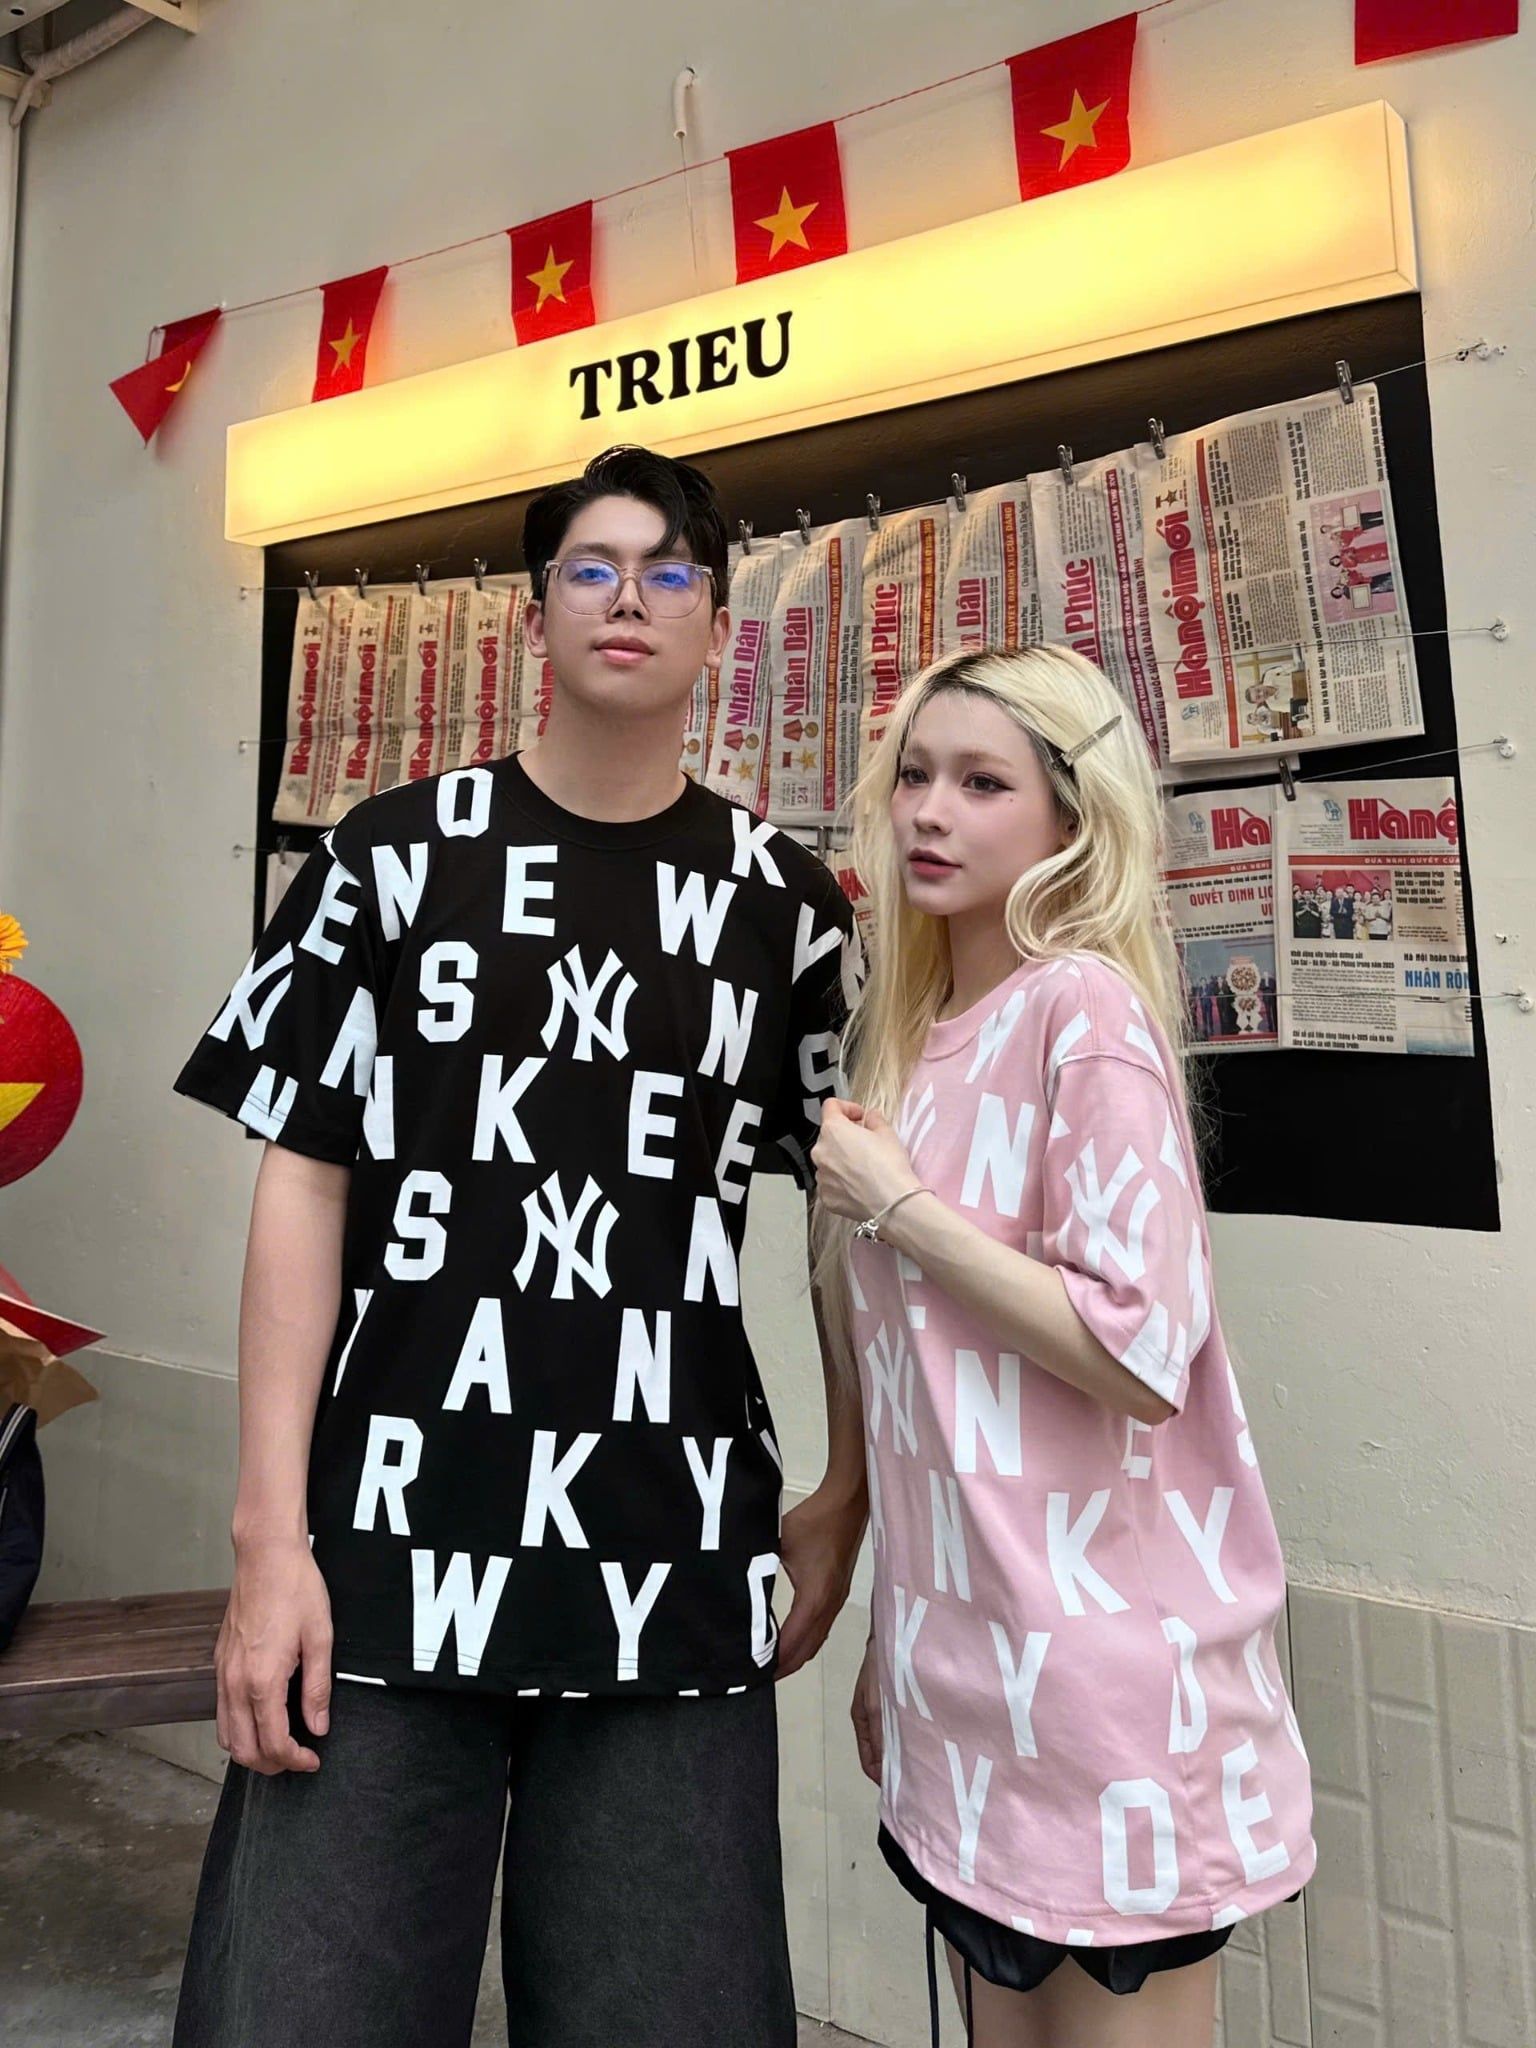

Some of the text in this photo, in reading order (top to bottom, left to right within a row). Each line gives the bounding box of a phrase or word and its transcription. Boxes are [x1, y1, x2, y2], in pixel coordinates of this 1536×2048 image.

[569, 310, 793, 420] TRIEU
[733, 620, 760, 662] Dân
[870, 582, 898, 653] Phúc
[956, 578, 981, 627] Dân
[1061, 558, 1094, 635] Phúc
[726, 667, 752, 726] Nhân
[782, 607, 807, 716] Nhân Dân
[437, 768, 493, 838] O
[731, 808, 786, 888] K
[1210, 808, 1272, 850] Hà
[299, 860, 362, 965] E
[371, 842, 428, 941] N
[502, 845, 558, 936] E
[657, 861, 737, 967] W
[1189, 888, 1223, 907] QUYẾT
[1228, 887, 1254, 904] ĐỊNH
[418, 941, 479, 1043] S
[540, 944, 639, 1062] NY
[697, 978, 759, 1086] N
[1404, 966, 1440, 989] NHÂN
[472, 1054, 548, 1164] K
[628, 1070, 684, 1180] E
[715, 1099, 763, 1205] E
[960, 1092, 1035, 1217] N
[384, 1170, 452, 1280] S
[512, 1170, 619, 1299] NY
[442, 1297, 512, 1414] A
[613, 1308, 671, 1423] N
[955, 1349, 1021, 1476] N
[353, 1414, 423, 1536] R
[520, 1430, 601, 1549] K
[682, 1437, 734, 1551] Y
[928, 1469, 971, 1602] N
[1046, 1489, 1131, 1616] K
[1163, 1487, 1238, 1603] Y
[411, 1549, 513, 1676] W
[600, 1562, 672, 1681] Y
[894, 1585, 933, 1721] K
[988, 1621, 1052, 1758] Y
[944, 1740, 993, 1885] Y
[1099, 1777, 1179, 1915] O
[1221, 1738, 1290, 1886] E
